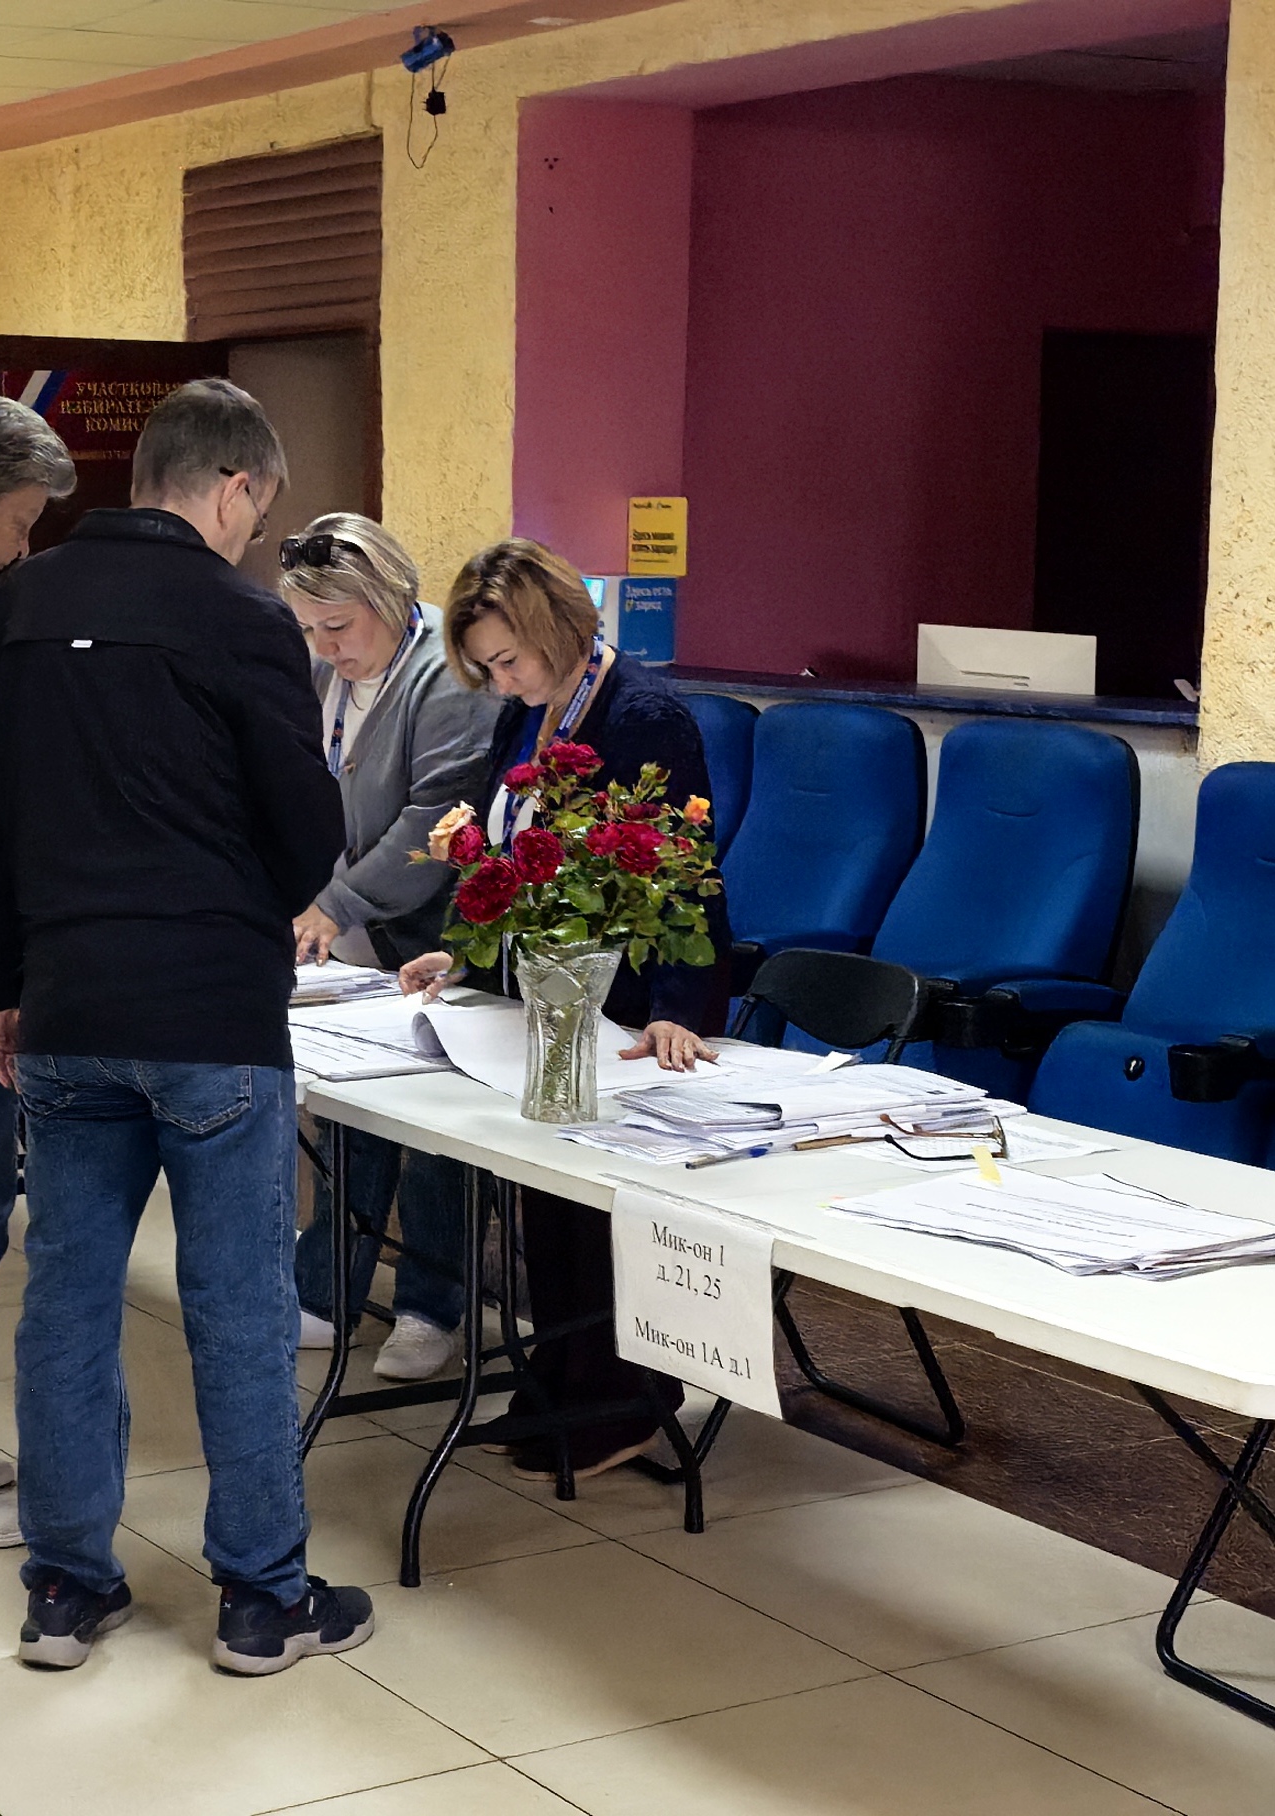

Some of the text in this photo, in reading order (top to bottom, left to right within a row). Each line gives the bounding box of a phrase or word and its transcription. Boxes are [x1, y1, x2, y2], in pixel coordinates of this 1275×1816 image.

[651, 1220, 725, 1268] Мик-он 1
[656, 1263, 722, 1300] д. 21, 25
[634, 1316, 752, 1380] Мик-он 1А д.1
